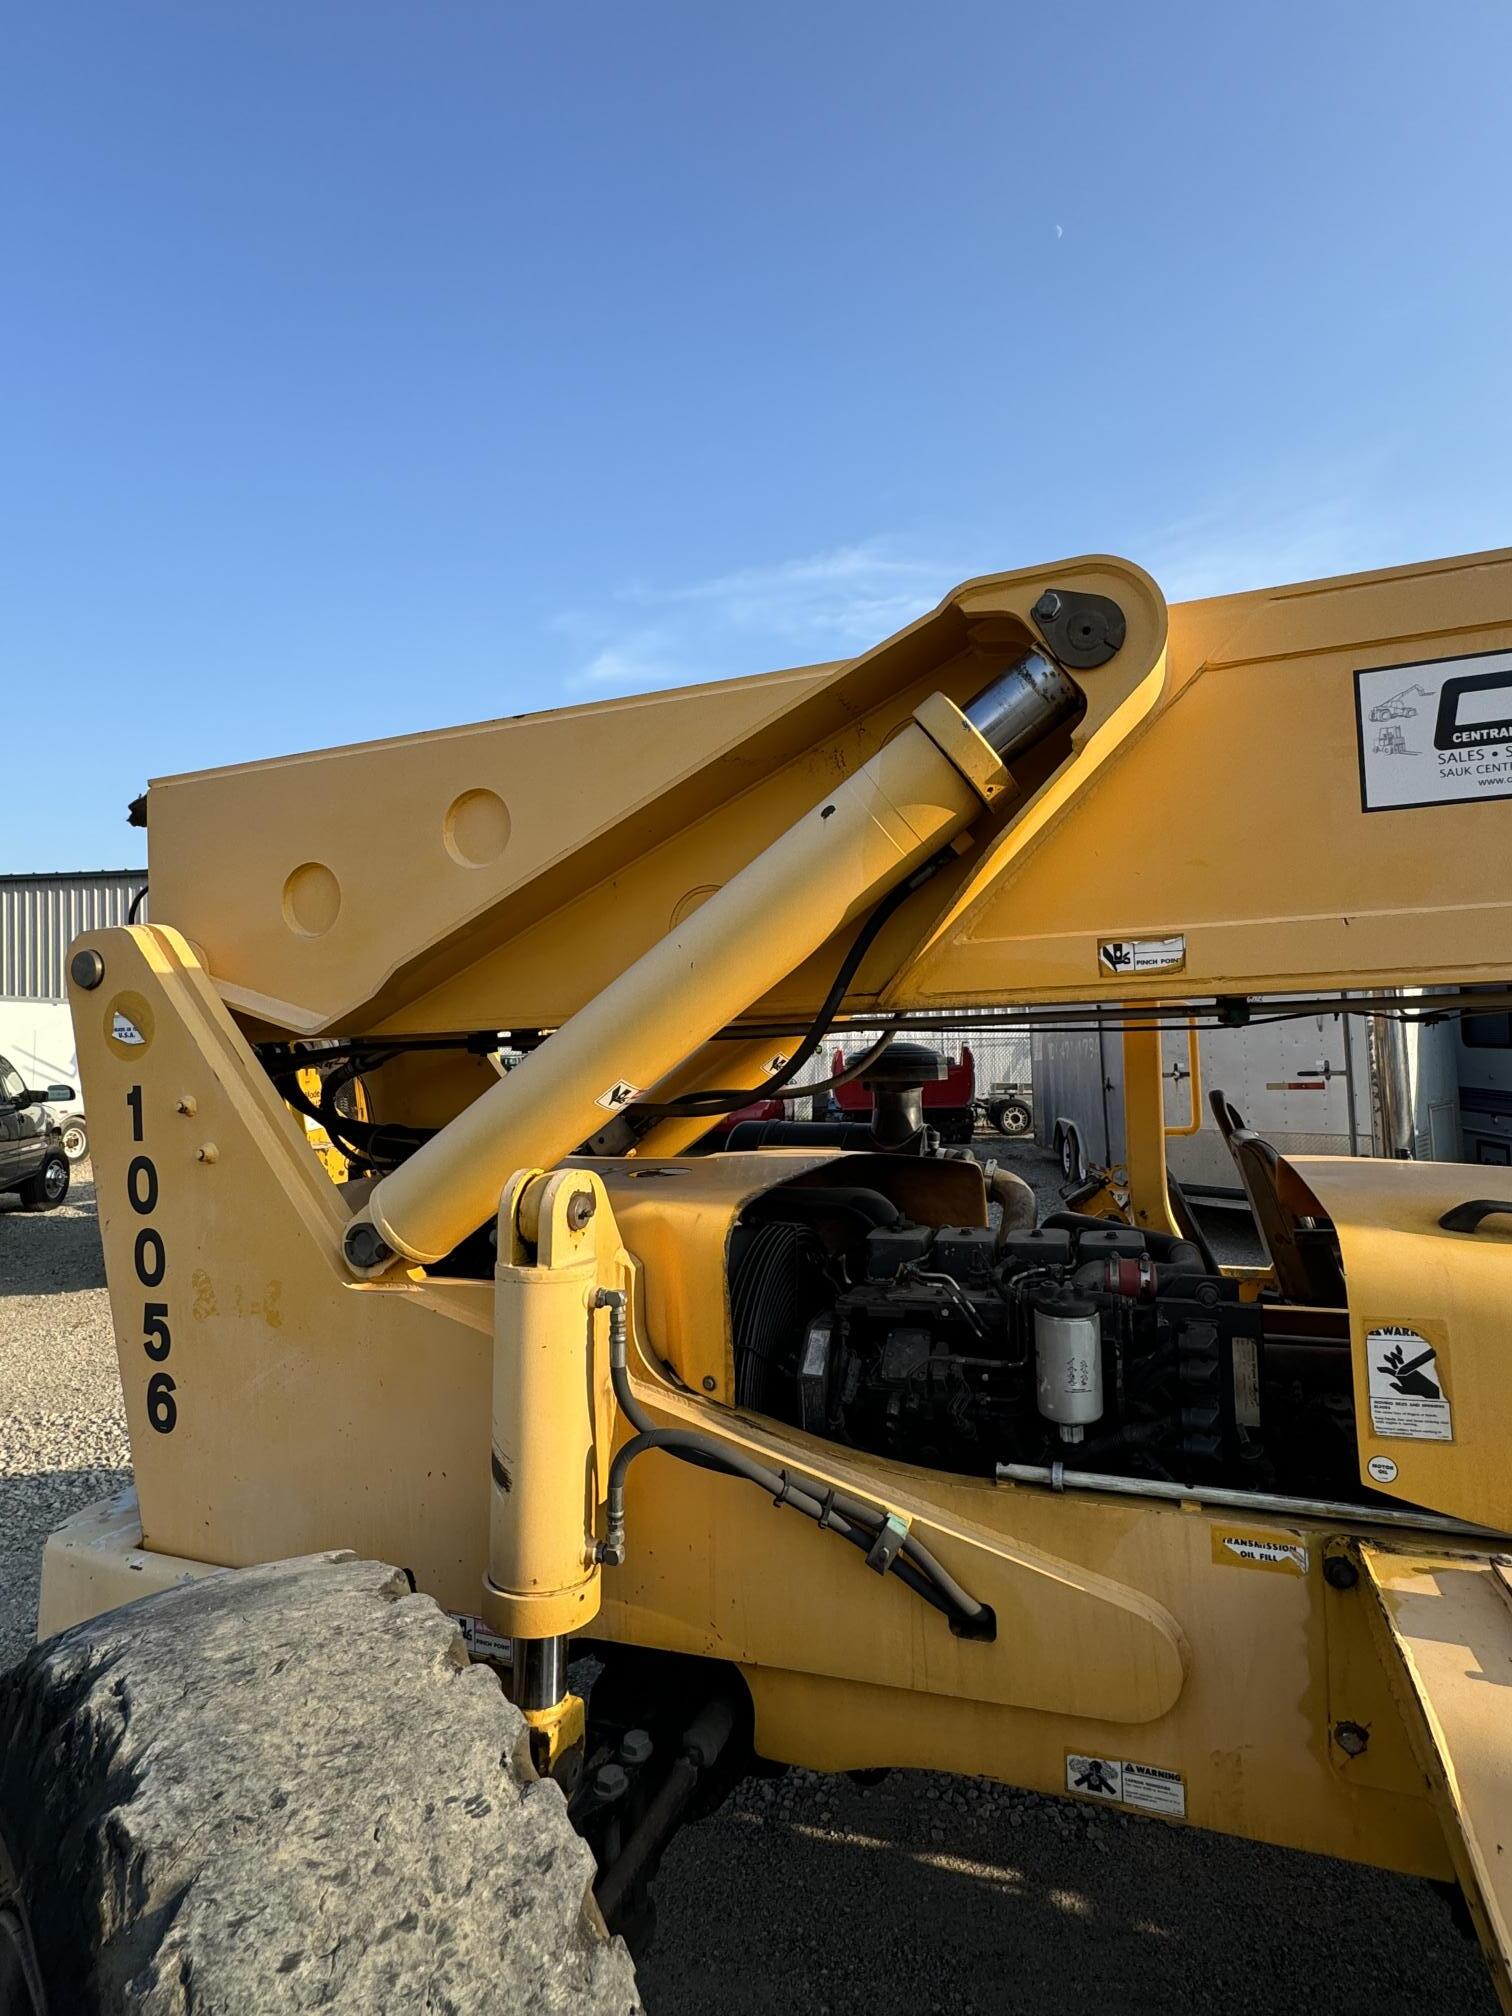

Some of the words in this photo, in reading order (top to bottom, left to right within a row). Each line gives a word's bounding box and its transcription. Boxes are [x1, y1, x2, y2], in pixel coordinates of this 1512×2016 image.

[1438, 748, 1485, 765] SALES
[1439, 766, 1472, 779] SAUK
[1476, 762, 1512, 774] CENT
[118, 1031, 136, 1039] U.S.A.
[1240, 1550, 1256, 1559] OIL
[1259, 1553, 1278, 1562] FILL
[1136, 1765, 1182, 1782] WARNING
